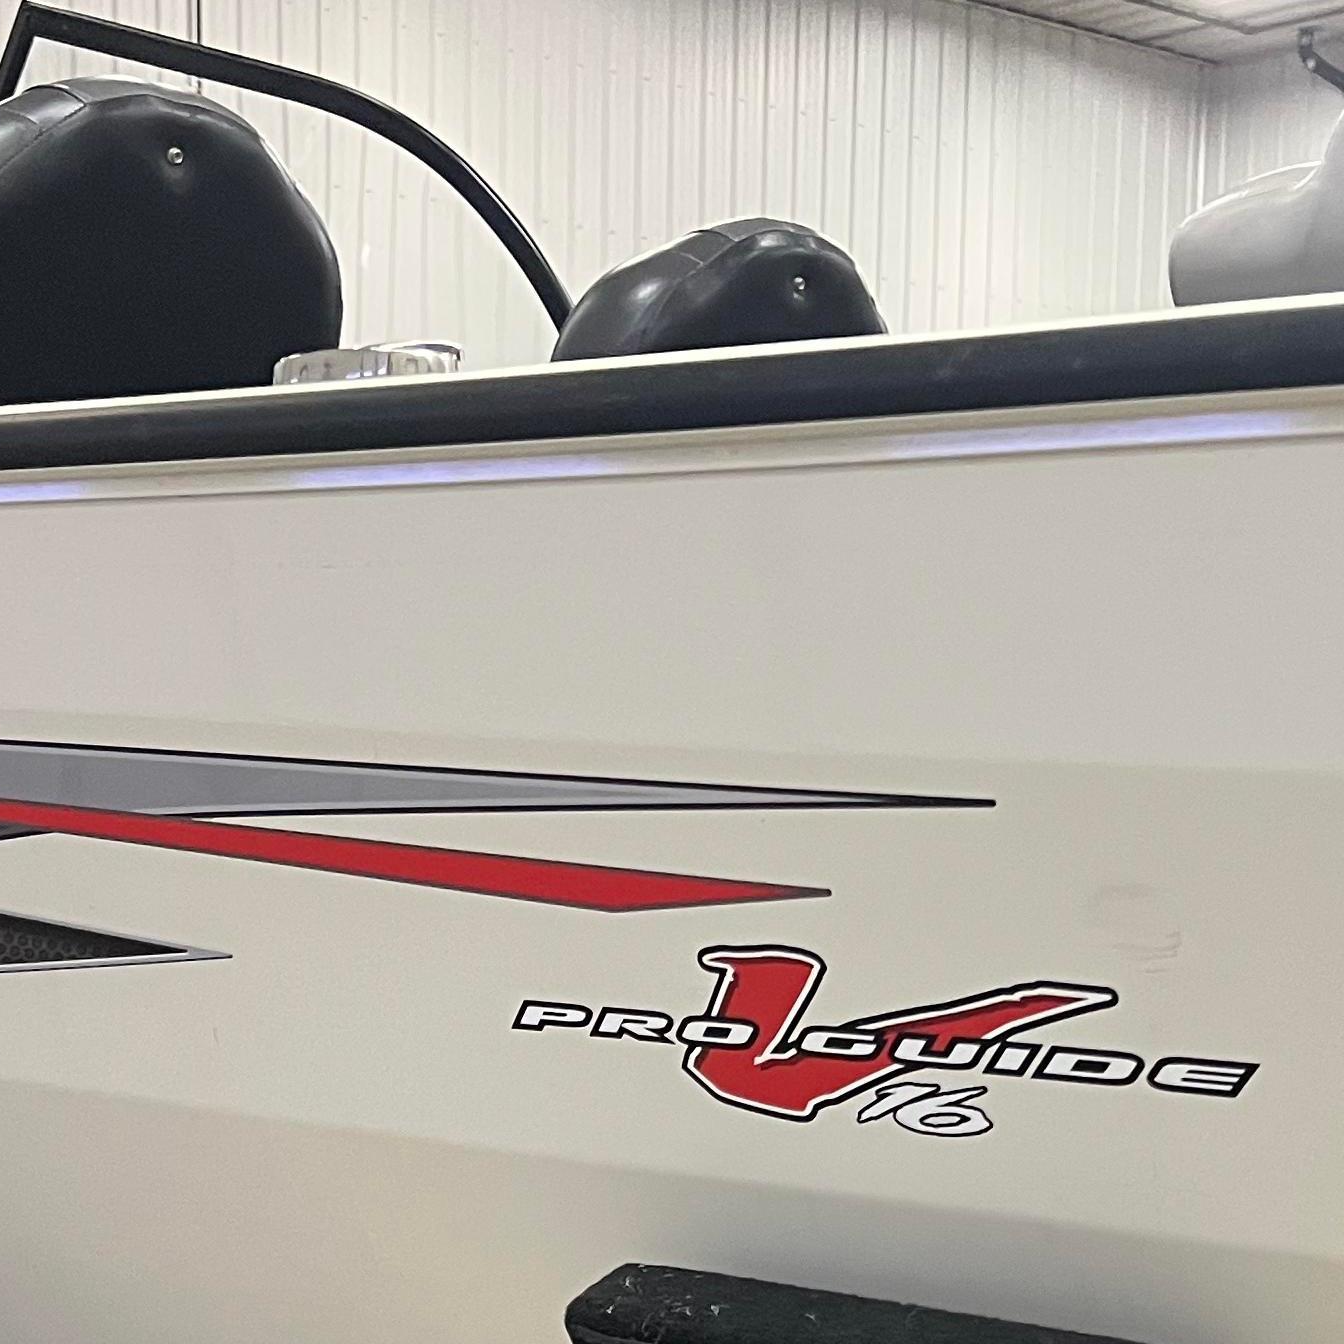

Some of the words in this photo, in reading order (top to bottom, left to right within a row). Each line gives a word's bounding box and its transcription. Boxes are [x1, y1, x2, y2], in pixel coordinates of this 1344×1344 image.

[512, 999, 759, 1048] PRO
[796, 1026, 1261, 1099] GUIDE
[856, 1081, 994, 1138] 16
